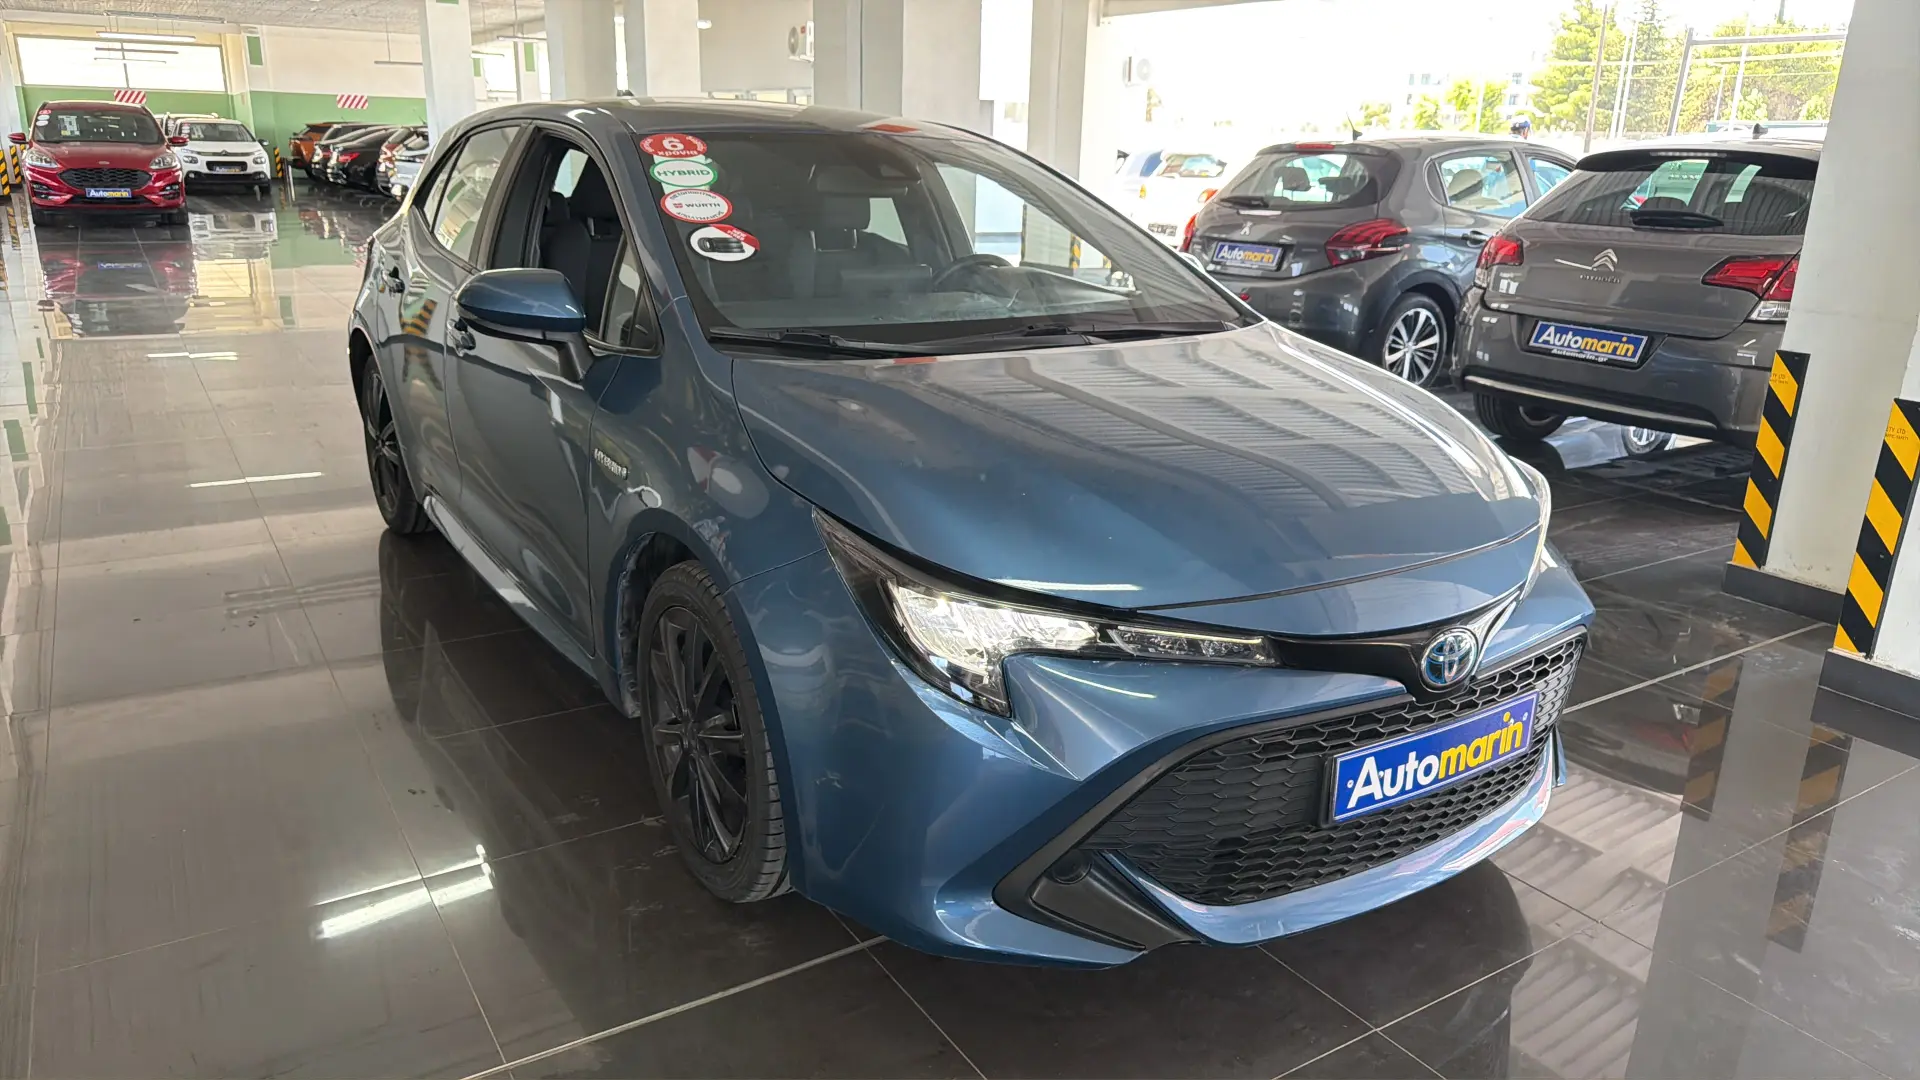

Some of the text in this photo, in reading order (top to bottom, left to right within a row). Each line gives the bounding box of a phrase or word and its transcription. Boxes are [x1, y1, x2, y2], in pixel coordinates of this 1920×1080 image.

[662, 135, 684, 151] 6
[90, 189, 129, 197] Automarin
[1217, 245, 1274, 263] Automarin
[1538, 325, 1635, 357] Automarin
[1551, 348, 1608, 362] Automarin.gr
[1347, 711, 1524, 809] Automarin
